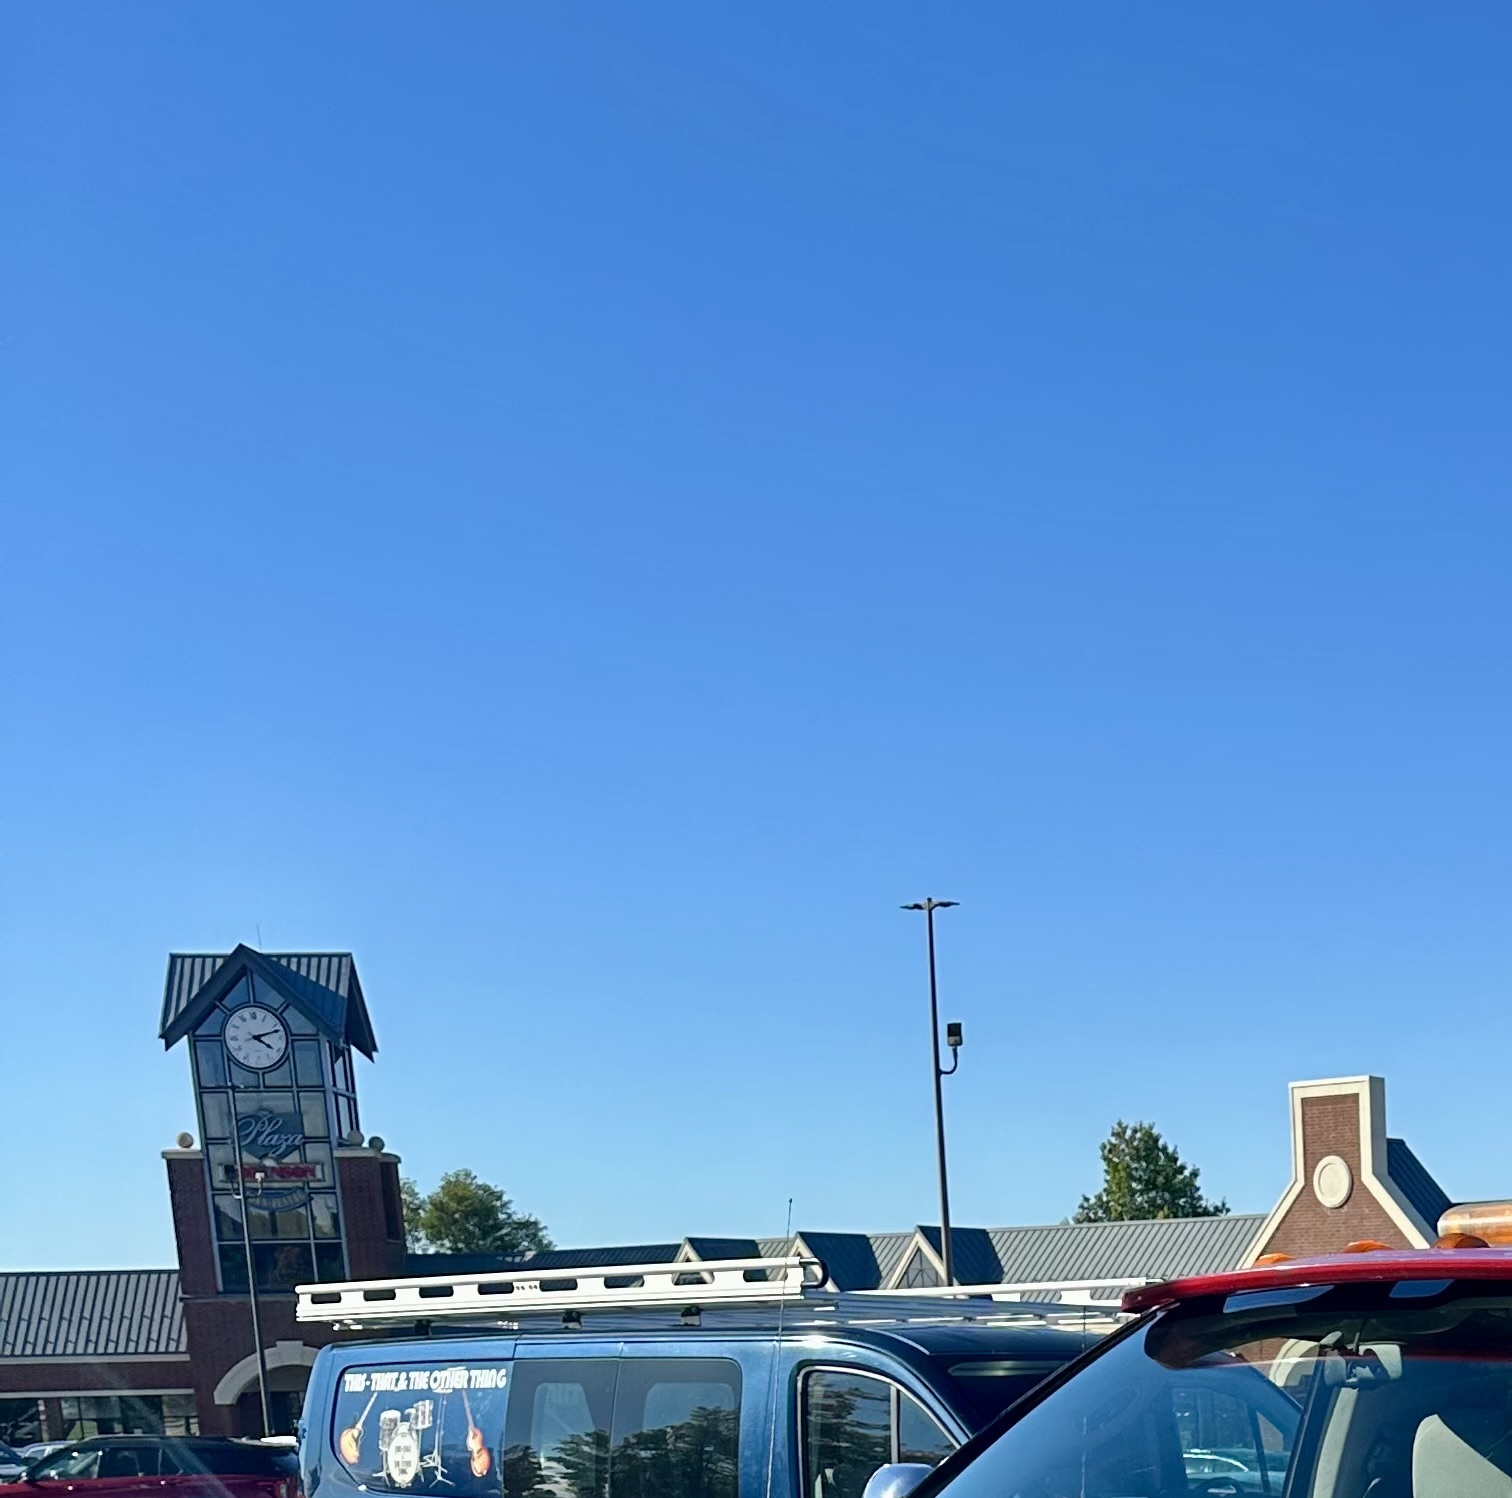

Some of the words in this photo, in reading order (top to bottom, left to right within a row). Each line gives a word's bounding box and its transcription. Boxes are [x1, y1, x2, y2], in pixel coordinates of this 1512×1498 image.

[239, 1110, 305, 1158] Plaza
[408, 1370, 430, 1390] THE
[430, 1366, 469, 1394] OTHER
[469, 1368, 507, 1389] THING
